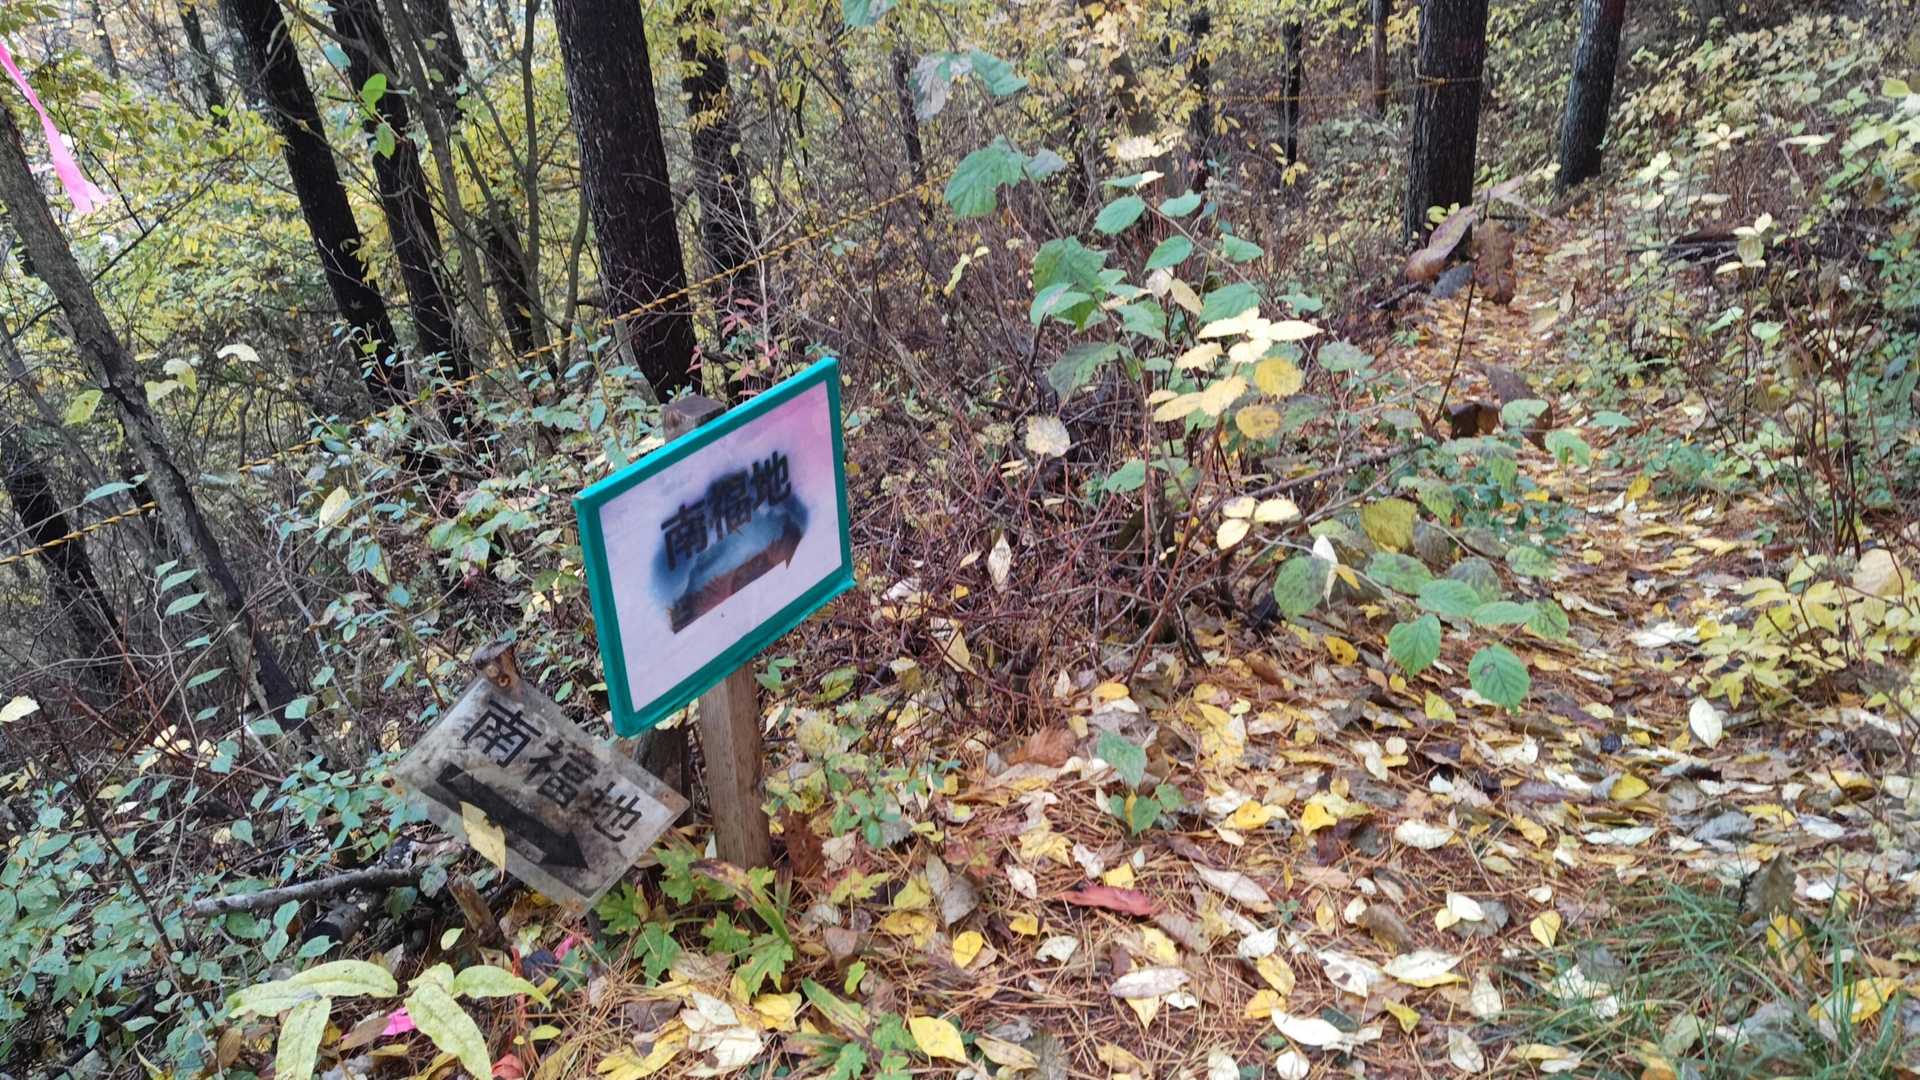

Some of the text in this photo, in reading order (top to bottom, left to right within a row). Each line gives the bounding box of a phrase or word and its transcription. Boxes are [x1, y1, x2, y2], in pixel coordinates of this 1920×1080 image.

[660, 451, 792, 571] 南福地
[461, 699, 642, 842] 南福地
